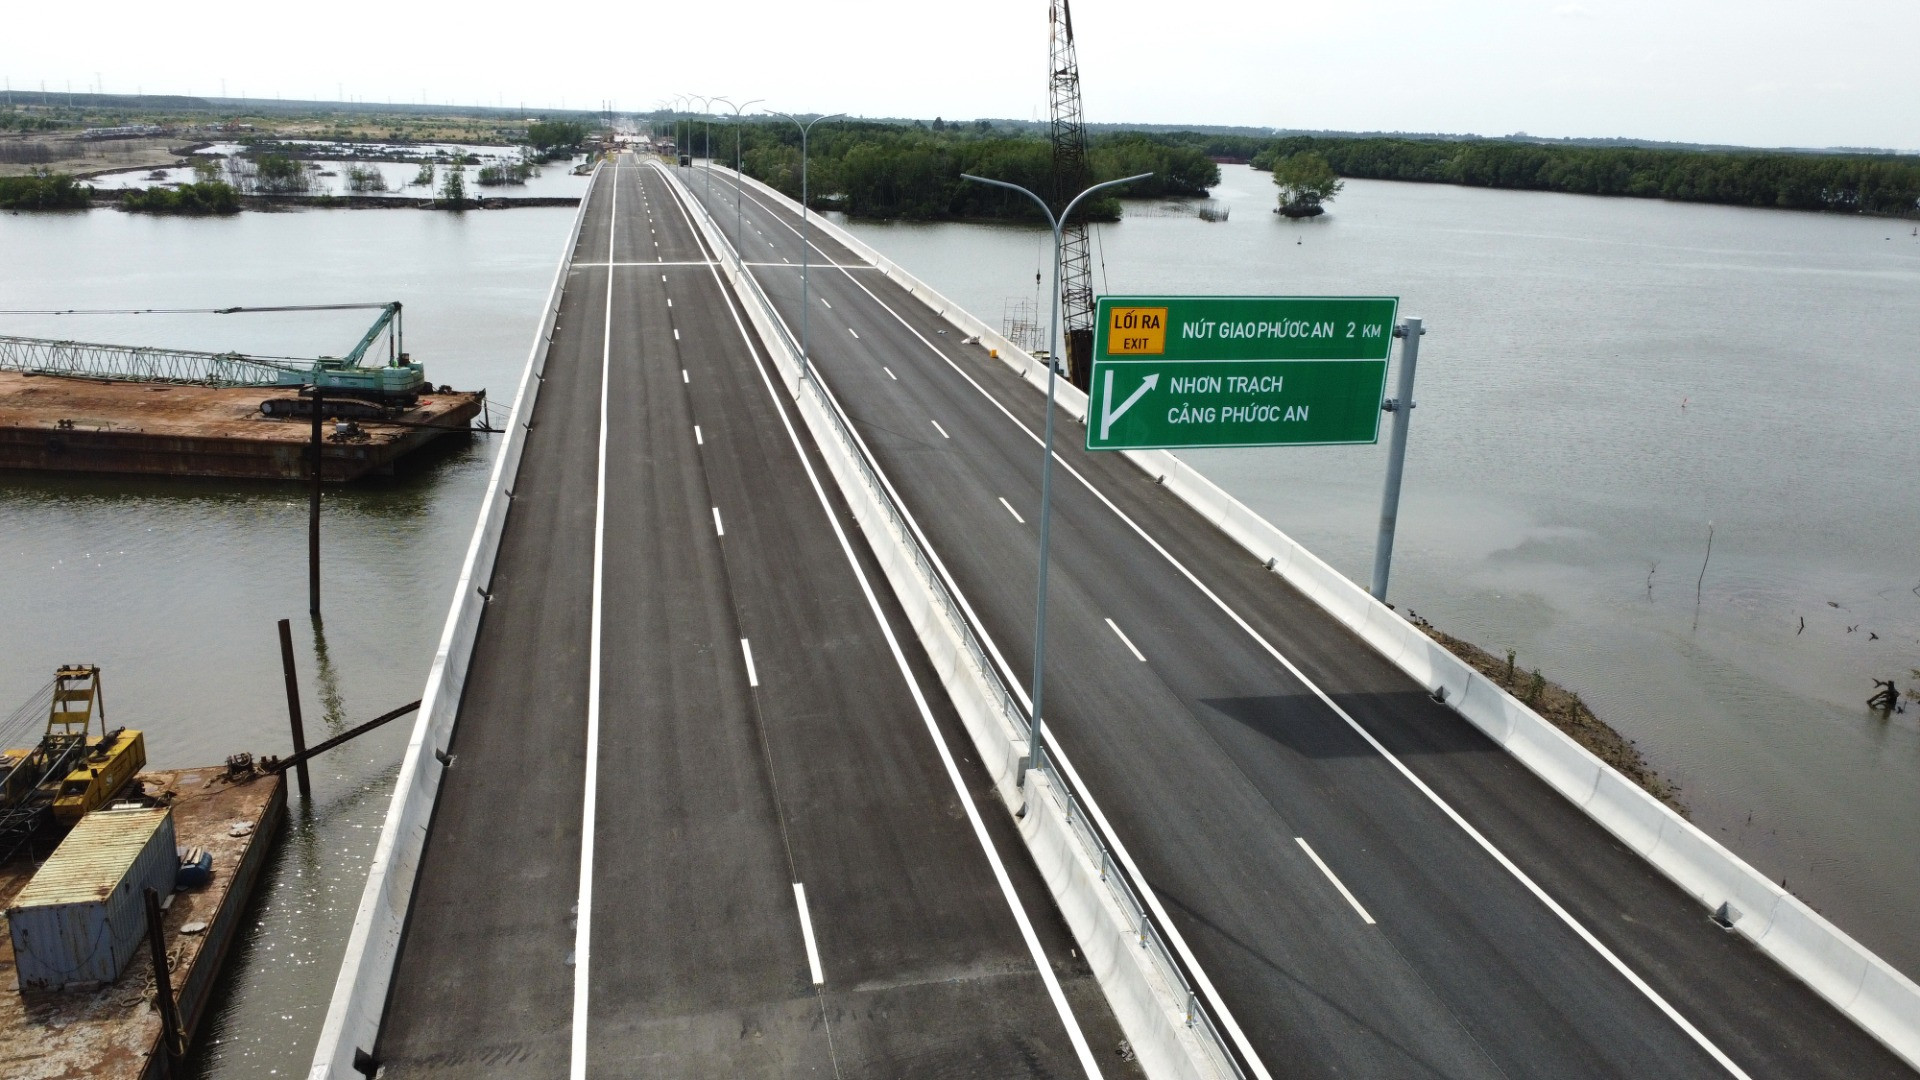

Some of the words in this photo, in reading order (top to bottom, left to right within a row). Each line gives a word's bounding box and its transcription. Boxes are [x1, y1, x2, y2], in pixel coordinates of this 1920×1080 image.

[1115, 309, 1137, 329] LỐI
[1142, 315, 1160, 329] RA
[1182, 317, 1216, 339] NÚT
[1311, 320, 1335, 338] AN
[1346, 321, 1356, 338] 2
[1362, 324, 1382, 338] KM
[1123, 337, 1149, 350] EXIT
[1170, 375, 1222, 394] NHƠN
[1226, 375, 1284, 396] TRẠCH
[1167, 402, 1216, 424] CẢNG
[1283, 405, 1310, 422] AN
